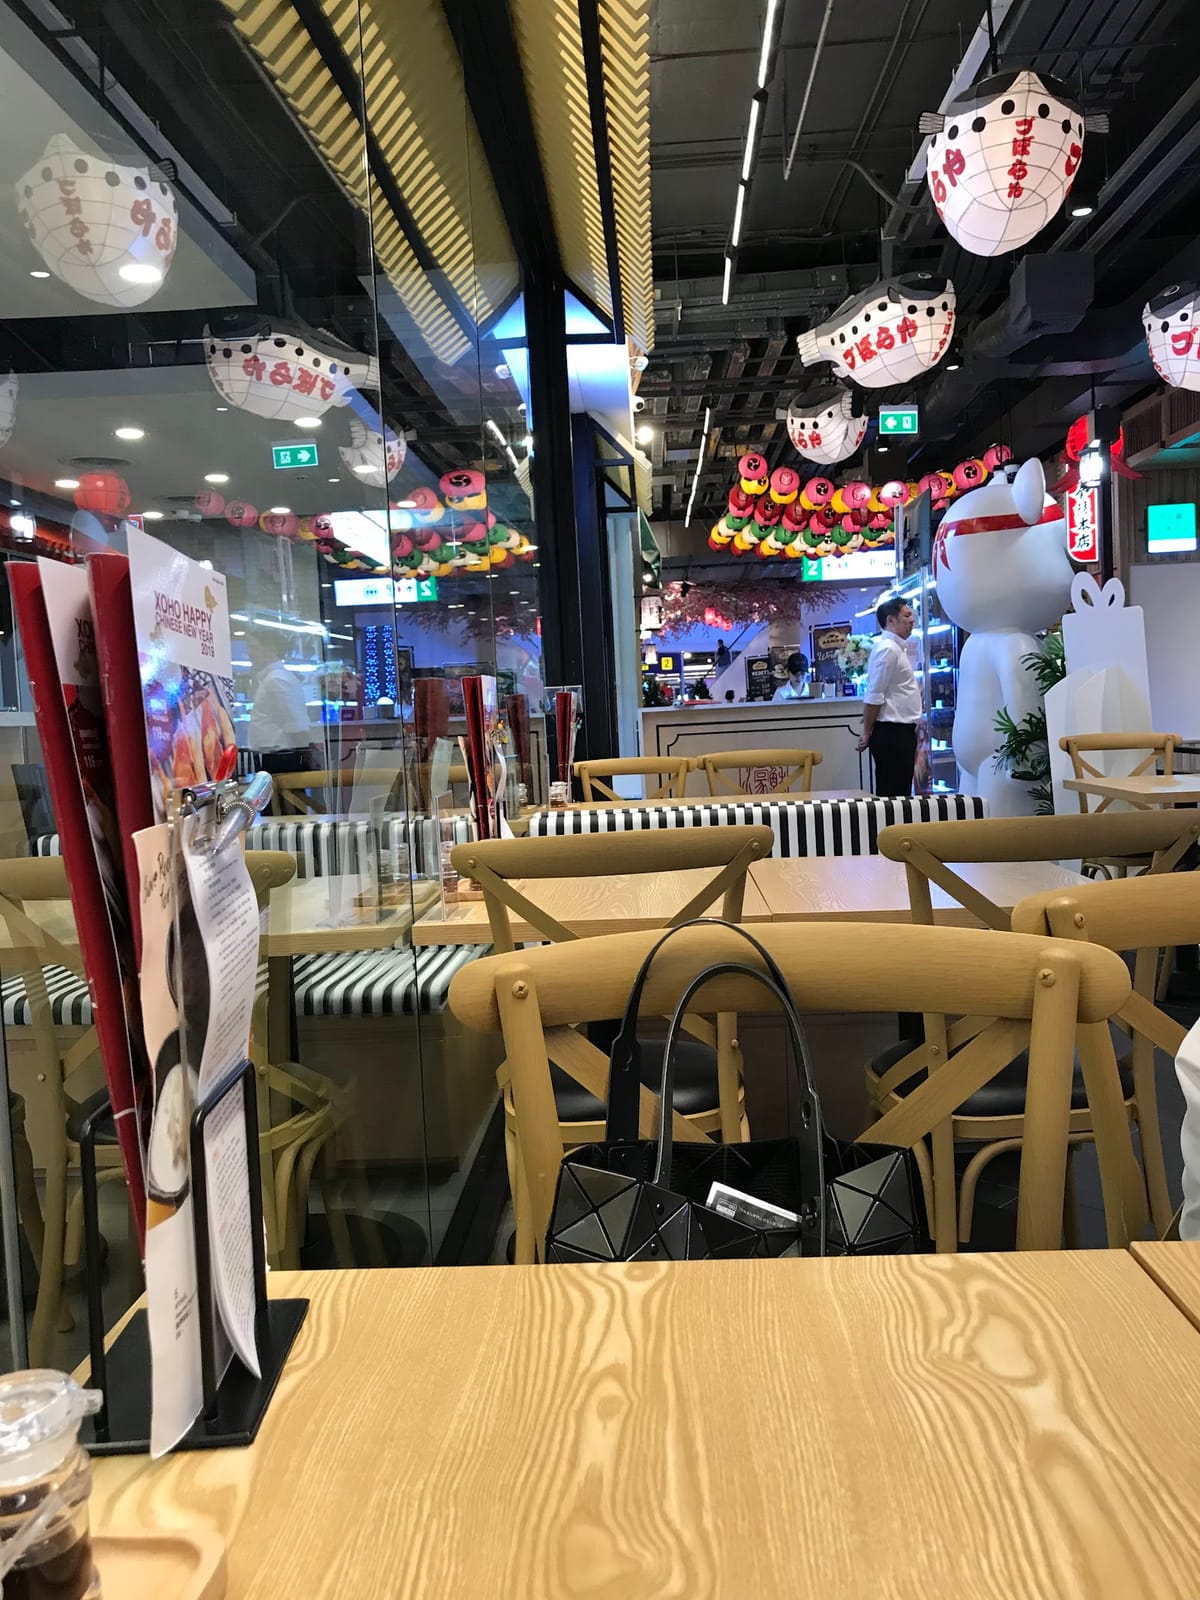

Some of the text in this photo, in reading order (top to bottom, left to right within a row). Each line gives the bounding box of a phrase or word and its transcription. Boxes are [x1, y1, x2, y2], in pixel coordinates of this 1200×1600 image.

[807, 561, 819, 576] 2
[154, 590, 212, 631] XOHO HAPPY
[155, 611, 214, 646] CHINESE NEW YEAR
